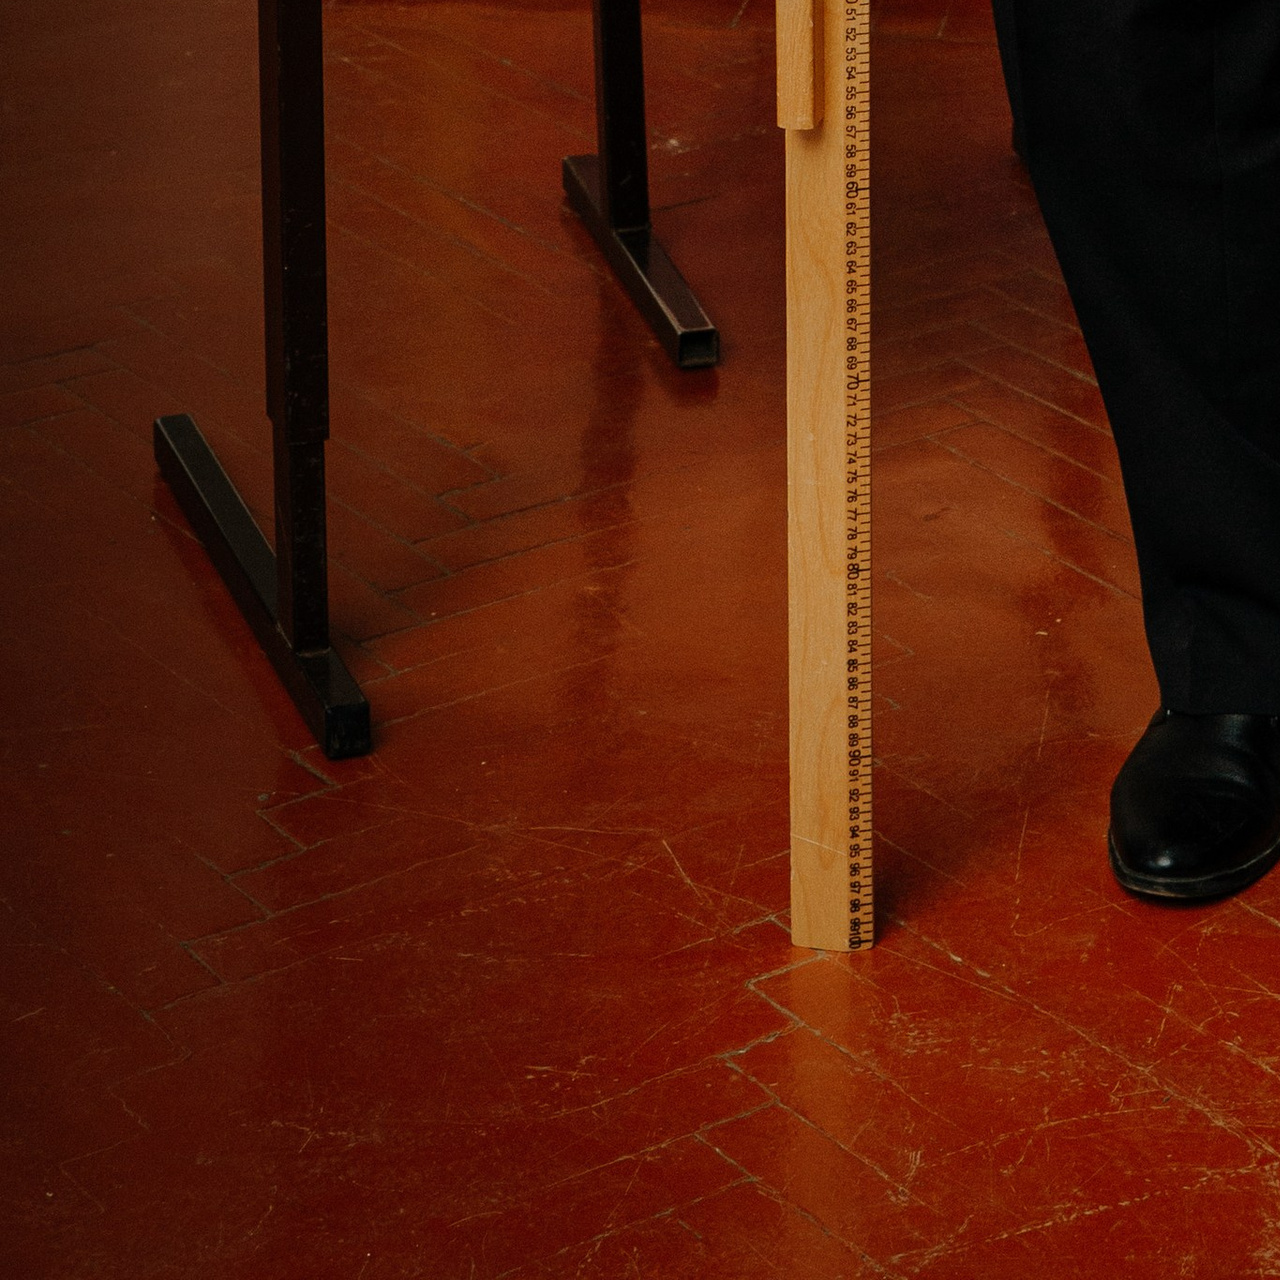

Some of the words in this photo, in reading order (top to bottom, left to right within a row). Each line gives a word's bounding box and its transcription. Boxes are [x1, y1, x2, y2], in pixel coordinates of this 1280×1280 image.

[846, 8, 856, 21] 51
[846, 28, 856, 41] 52
[846, 48, 856, 61] 53
[846, 67, 856, 80] 54
[846, 86, 856, 100] 55
[846, 106, 856, 119] 56
[846, 126, 856, 139] 57
[846, 145, 856, 158] 58
[846, 164, 856, 177] 59
[846, 181, 858, 198] 60
[846, 203, 856, 215] 61
[846, 222, 857, 236] 62
[846, 241, 857, 255] 63
[846, 261, 857, 274] 64
[846, 280, 857, 294] 65
[846, 299, 857, 313] 66
[846, 318, 857, 331] 67
[846, 337, 857, 351] 68
[846, 356, 857, 370] 69
[847, 373, 859, 390] 70
[847, 394, 857, 406] 71
[847, 413, 857, 427] 72
[847, 432, 857, 446] 73
[847, 451, 857, 464] 74
[847, 470, 857, 483] 75
[847, 489, 857, 503] 76
[847, 508, 857, 521] 77
[847, 527, 857, 540] 78
[848, 546, 858, 559] 79
[848, 563, 860, 580] 80
[848, 584, 858, 595] 81
[848, 602, 858, 616] 82
[848, 621, 858, 635] 83
[848, 640, 858, 653] 84
[848, 658, 858, 672] 85
[848, 677, 858, 690] 86
[848, 696, 859, 709] 87
[848, 715, 859, 728] 88
[848, 733, 859, 747] 89
[848, 750, 861, 766] 90
[848, 770, 859, 782] 91
[848, 789, 859, 802] 92
[848, 807, 859, 820] 93
[848, 825, 859, 839] 94
[849, 844, 860, 858] 95
[849, 863, 860, 876] 96
[849, 881, 860, 894] 97
[849, 899, 860, 913] 98
[849, 918, 860, 931] 99
[849, 931, 860, 949] 100
